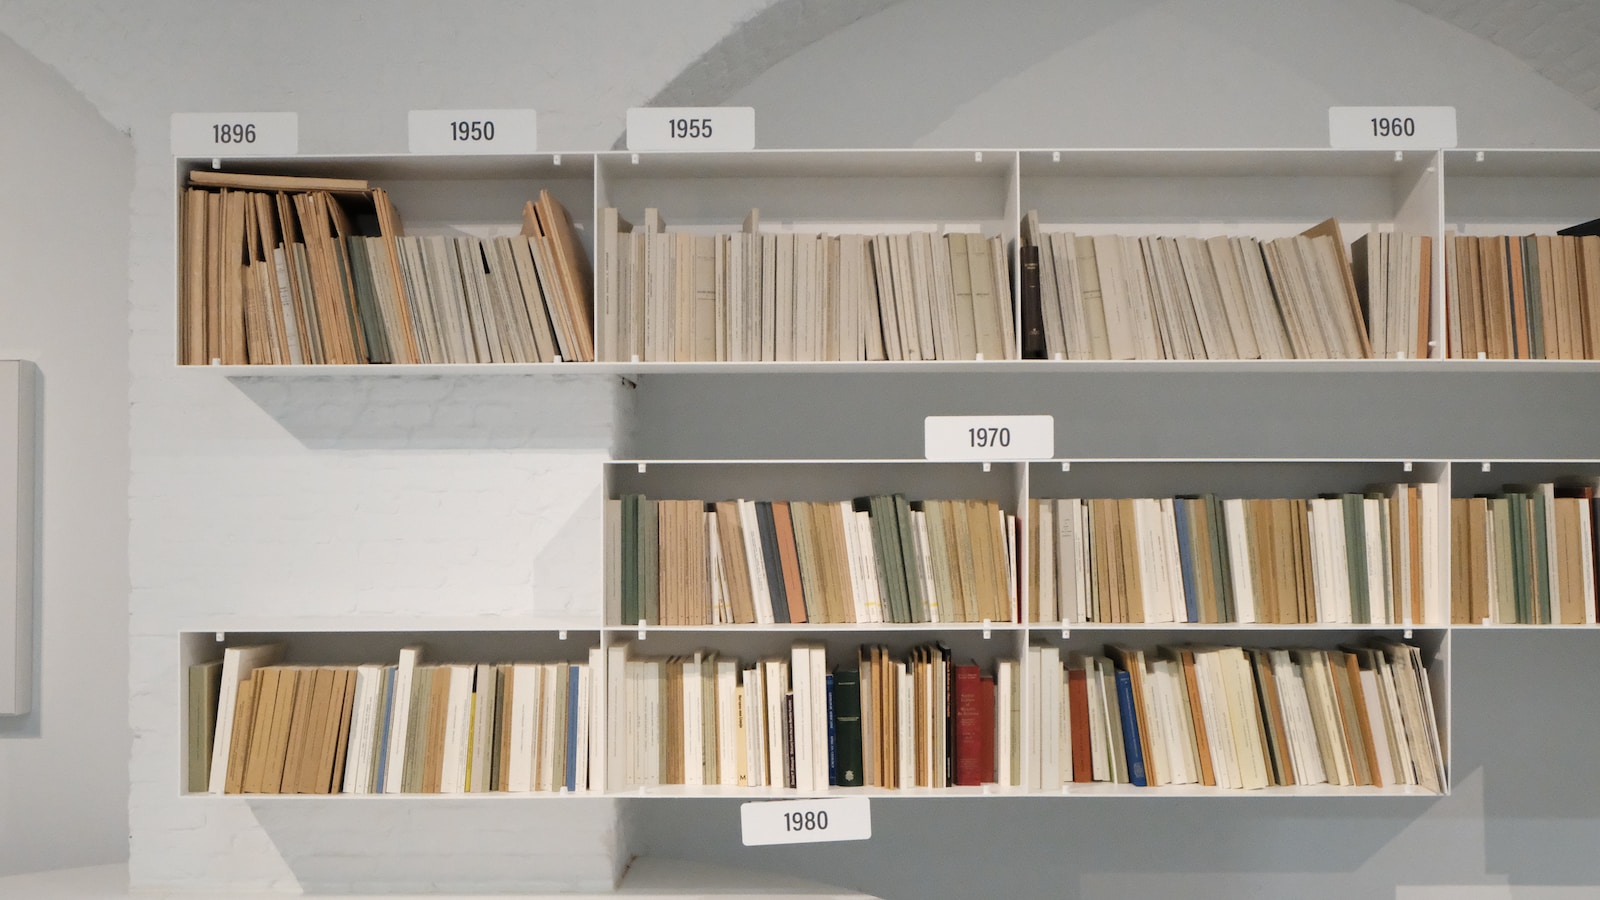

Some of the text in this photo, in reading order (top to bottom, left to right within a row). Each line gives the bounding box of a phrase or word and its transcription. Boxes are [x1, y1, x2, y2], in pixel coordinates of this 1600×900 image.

[213, 123, 256, 144] 1896
[450, 120, 495, 141] 1950
[669, 118, 713, 139] 1955
[1370, 117, 1415, 137] 1960
[968, 427, 1010, 448] 1970
[784, 810, 828, 832] 1980
